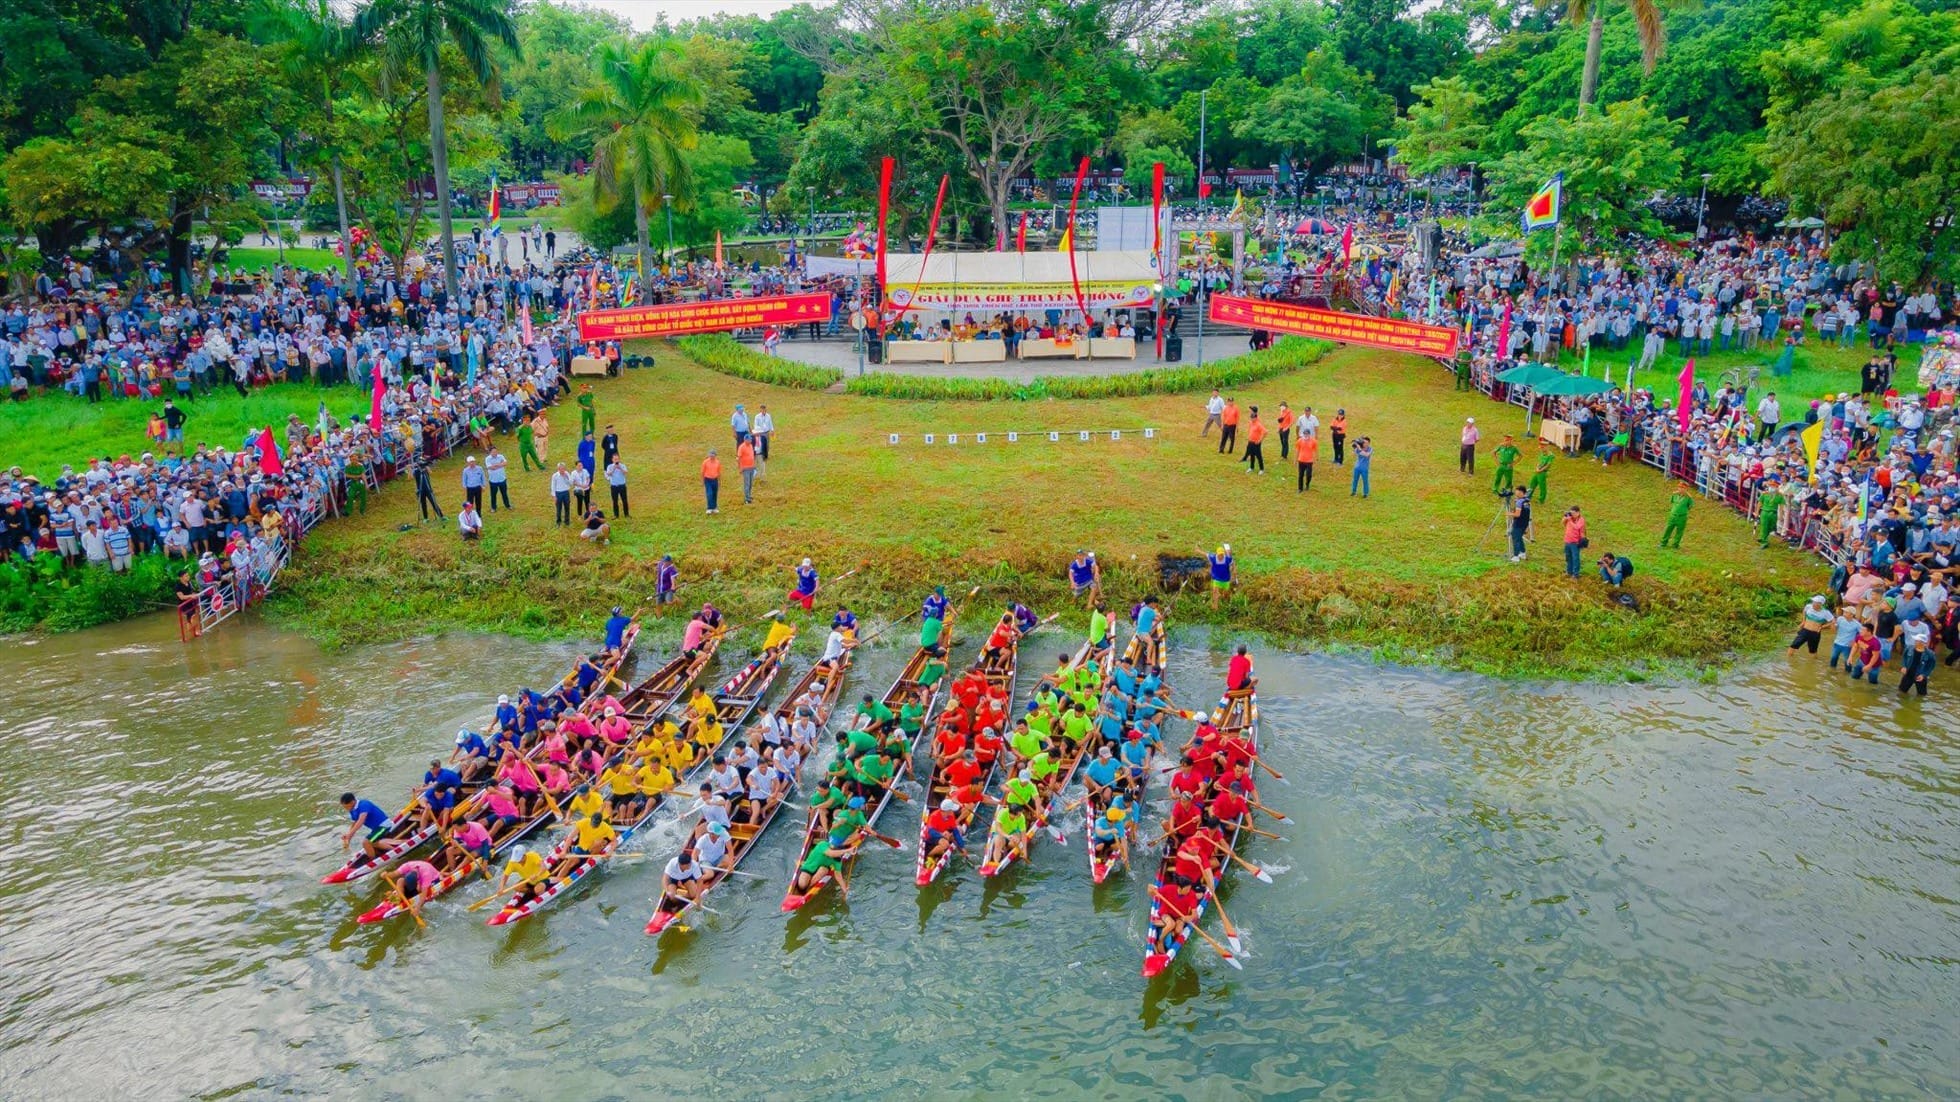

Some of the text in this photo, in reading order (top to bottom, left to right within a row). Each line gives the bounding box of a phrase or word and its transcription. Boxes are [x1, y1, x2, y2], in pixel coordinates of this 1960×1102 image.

[918, 292, 948, 302] GIẢI
[986, 294, 1012, 302] GHE
[1018, 290, 1074, 302] TRUYỀN
